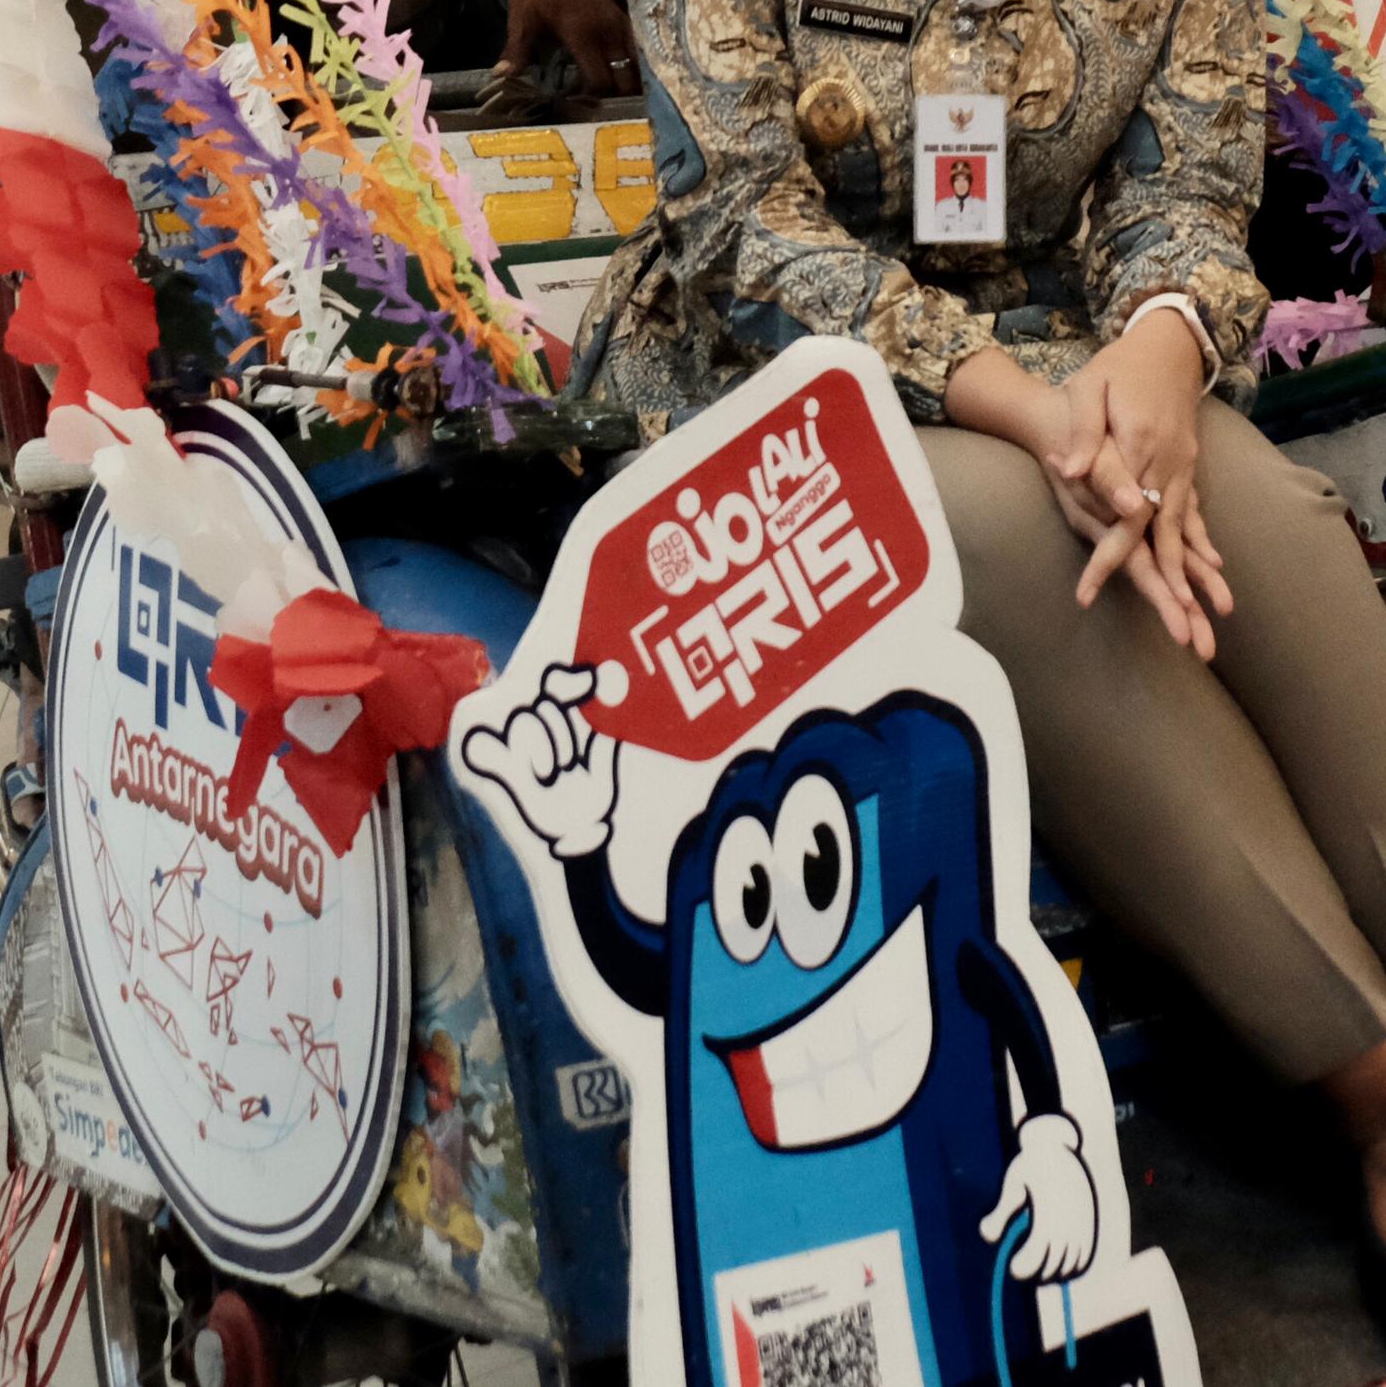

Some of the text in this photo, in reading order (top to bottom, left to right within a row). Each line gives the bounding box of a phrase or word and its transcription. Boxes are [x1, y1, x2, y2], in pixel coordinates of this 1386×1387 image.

[810, 6, 904, 34] ASTRID WIDAYANI
[775, 473, 832, 532] Nganggo
[655, 499, 879, 721] QRIS
[54, 1092, 147, 1164] Simpede
